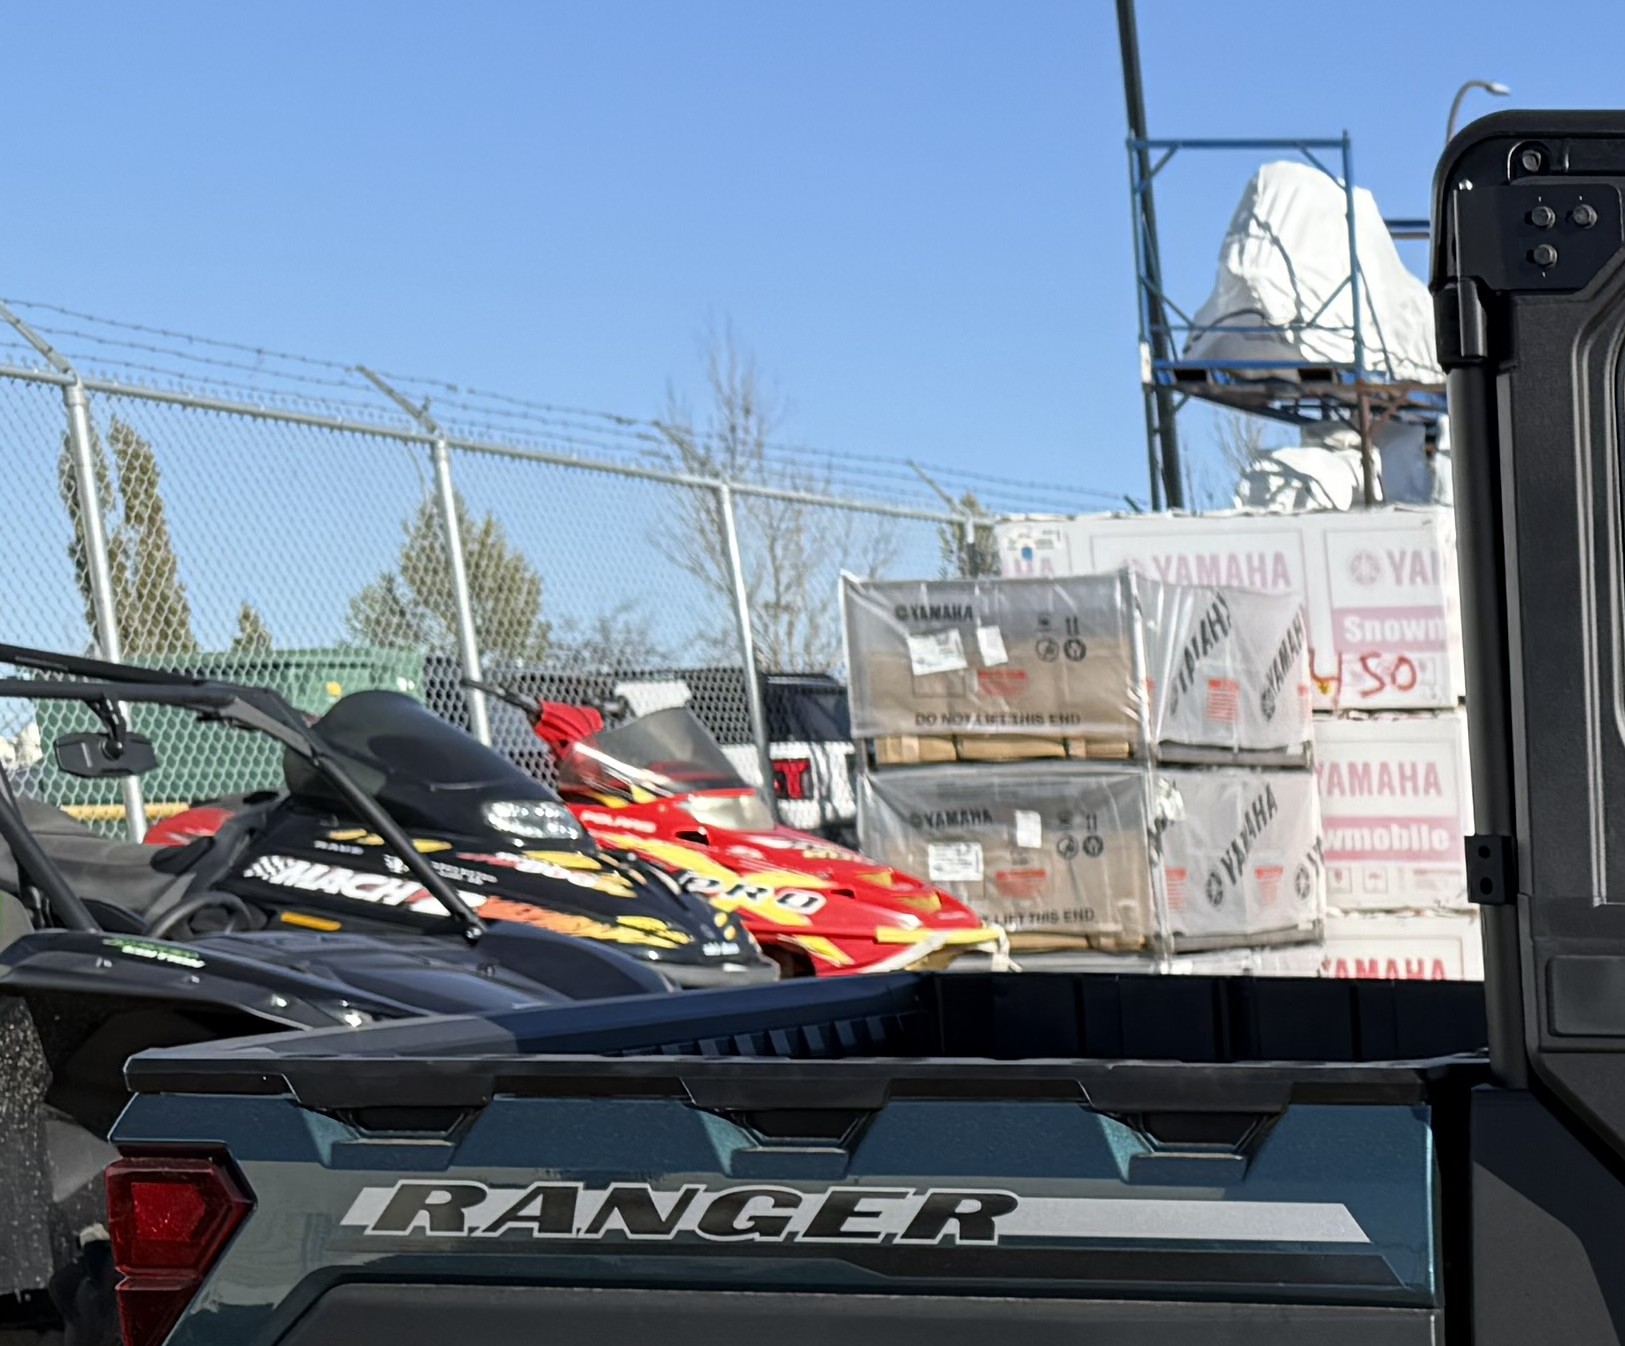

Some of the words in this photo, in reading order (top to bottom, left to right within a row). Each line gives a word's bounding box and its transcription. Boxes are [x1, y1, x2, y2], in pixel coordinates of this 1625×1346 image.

[1150, 551, 1294, 588] YAMAHA
[911, 604, 973, 620] YAMAHA
[915, 711, 937, 726] DO
[1049, 710, 1081, 726] END
[1314, 760, 1443, 797] YAMAHA
[923, 807, 993, 828] YAMAHA
[1324, 822, 1450, 851] wmobile
[1028, 912, 1059, 926] THIS
[1064, 909, 1095, 924] END
[364, 1180, 1019, 1246] RANGER
